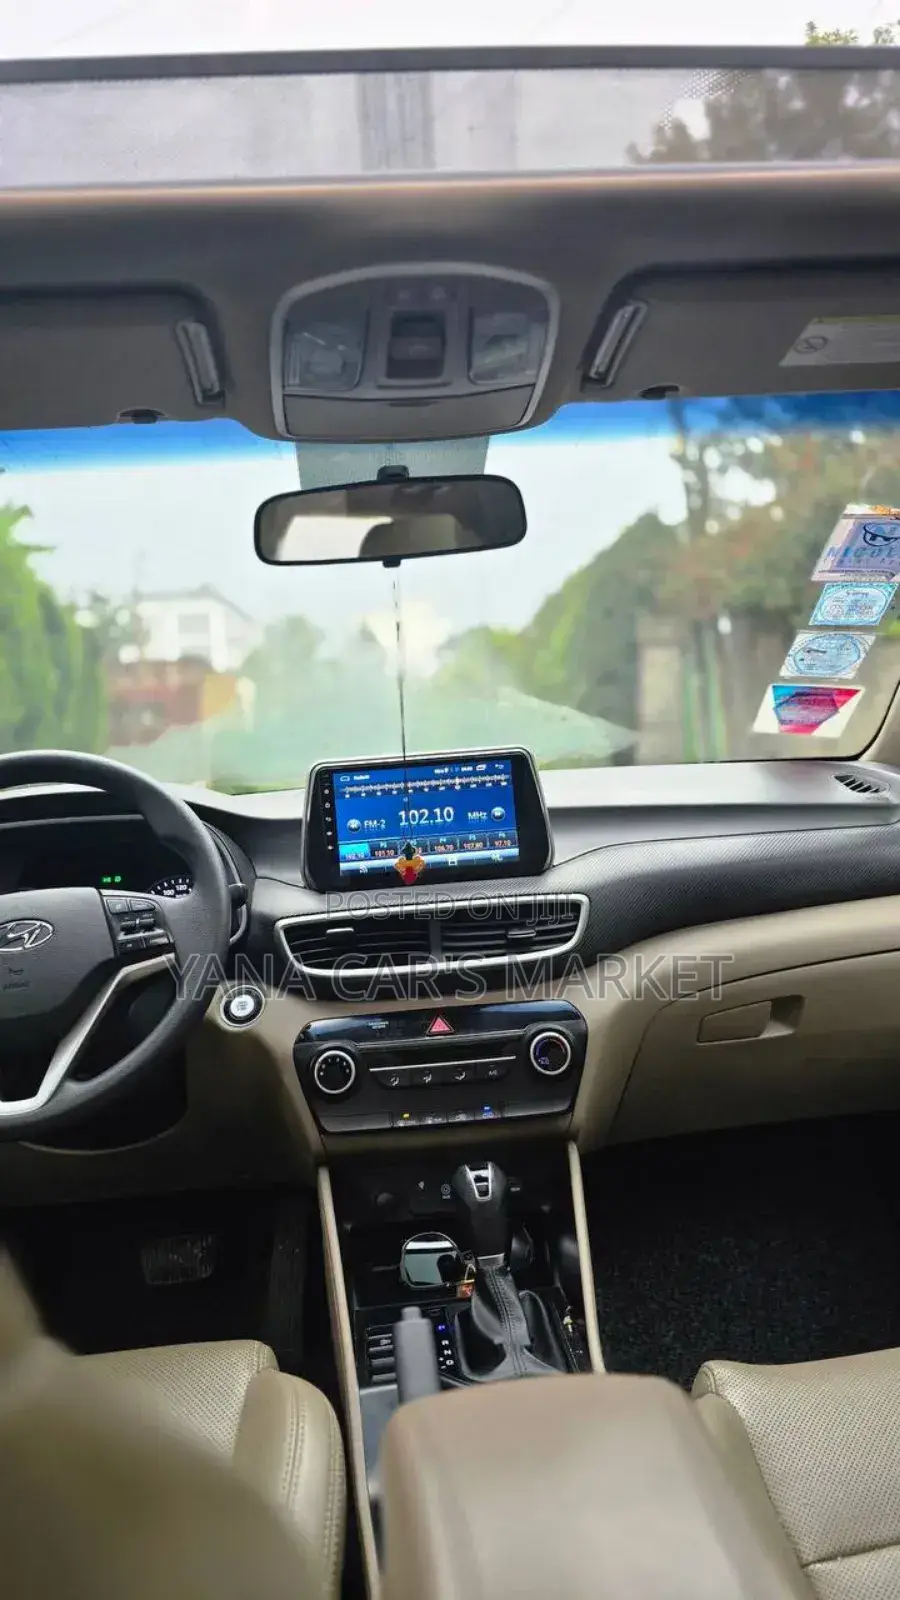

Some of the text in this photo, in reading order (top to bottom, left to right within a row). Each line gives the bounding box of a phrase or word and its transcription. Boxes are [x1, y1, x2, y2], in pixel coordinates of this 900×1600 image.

[363, 806, 487, 829] FM-2 102.10 MHz
